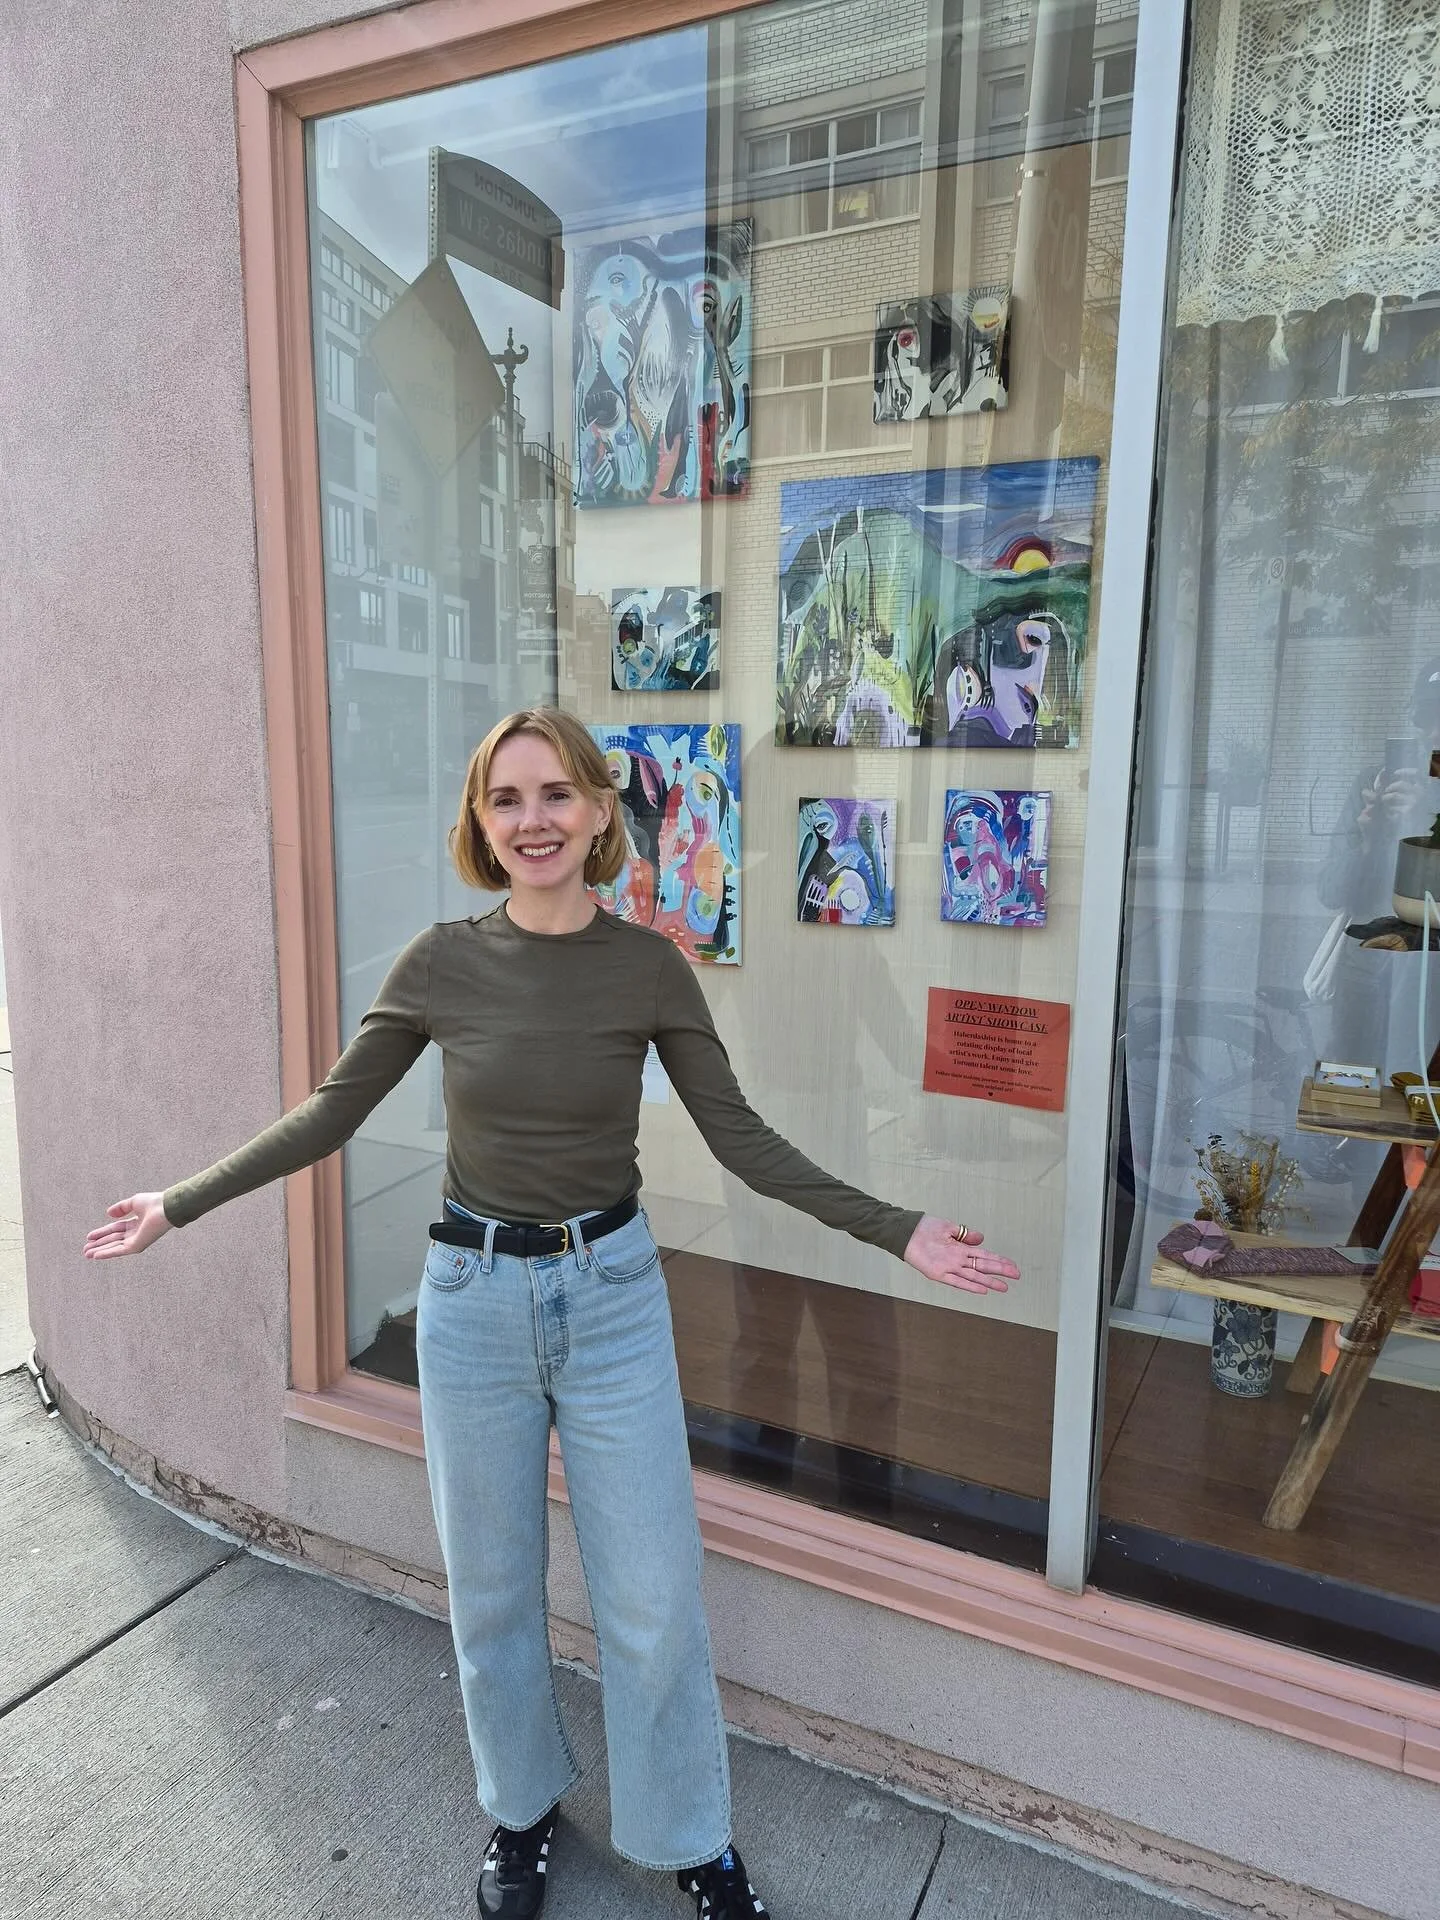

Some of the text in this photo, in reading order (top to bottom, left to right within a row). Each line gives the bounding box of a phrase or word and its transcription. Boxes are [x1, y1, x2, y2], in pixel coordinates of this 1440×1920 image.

[954, 999, 1039, 1017] OPEN WINDOW
[945, 1012, 1048, 1032] ARTIST SHOWCASE
[953, 1031, 996, 1042] Haberdashist
[1004, 1036, 1022, 1045] home
[956, 1041, 983, 1050] rotating
[983, 1044, 1007, 1054] display
[1016, 1048, 1032, 1056] local
[949, 1049, 1040, 1068] artist's work. Enjoy and give
[953, 1059, 1033, 1076] Toronto talent some love.
